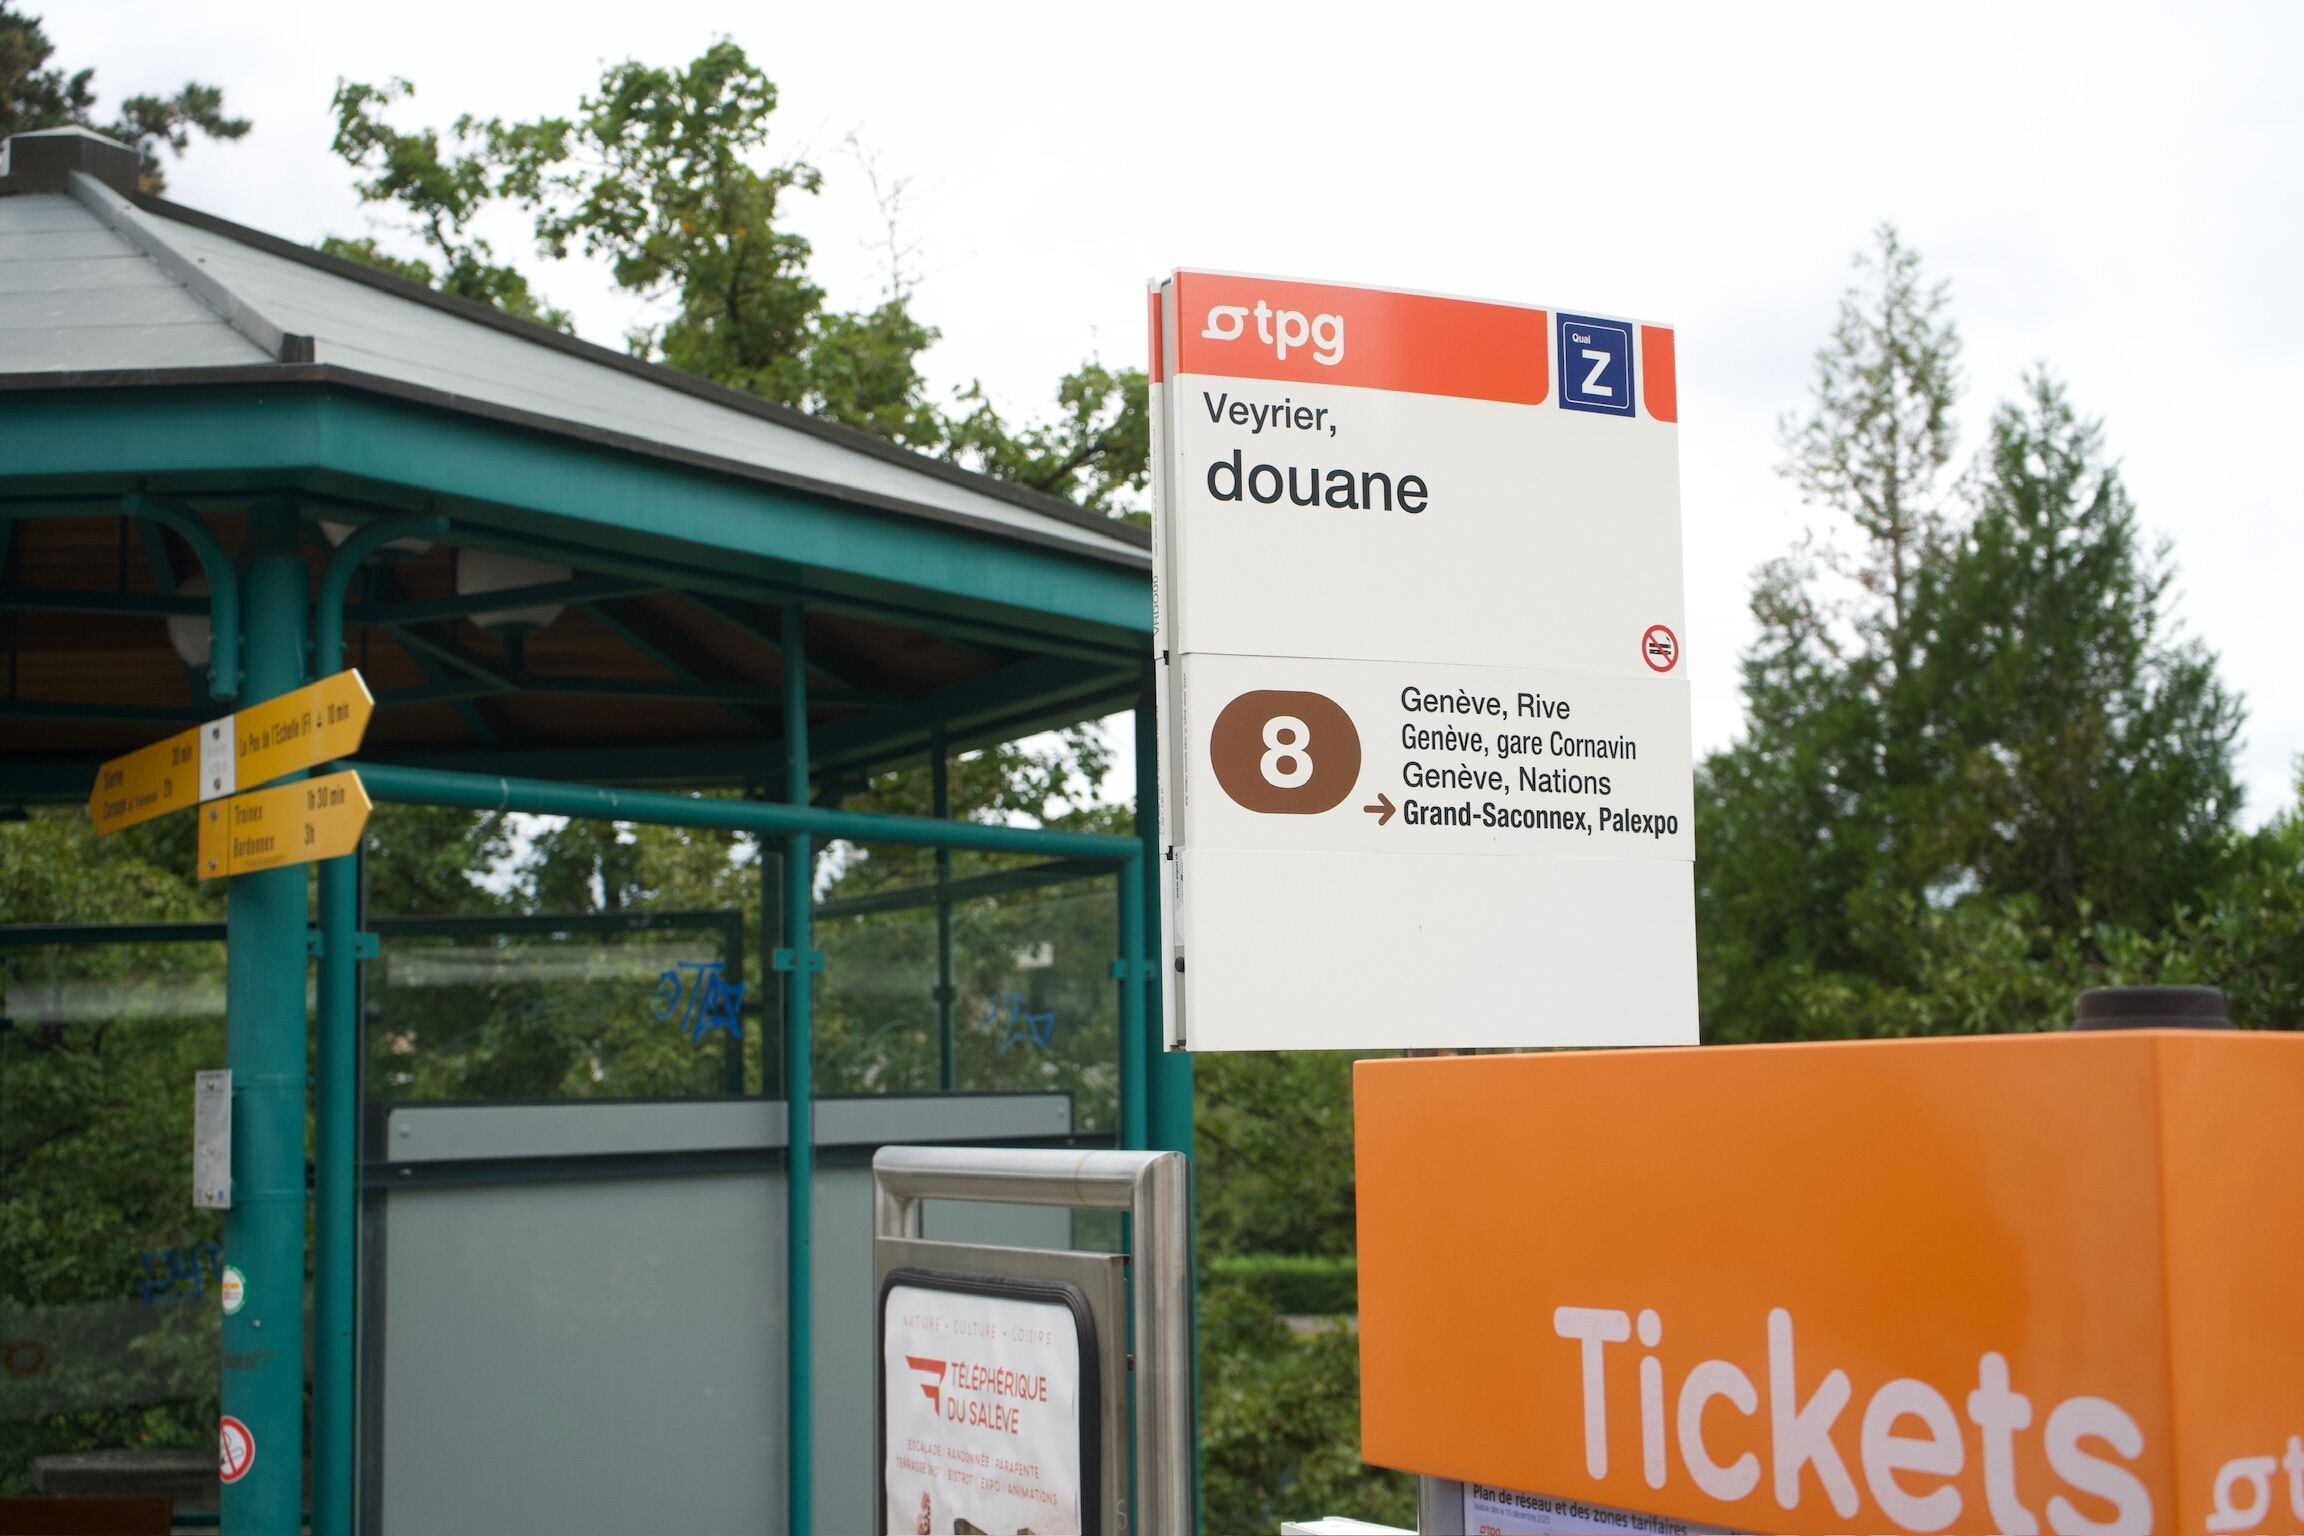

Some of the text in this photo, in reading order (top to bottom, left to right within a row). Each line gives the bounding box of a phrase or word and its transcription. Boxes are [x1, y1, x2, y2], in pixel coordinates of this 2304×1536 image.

[1571, 332, 1592, 345] Quai
[1580, 349, 1614, 397] Z
[1203, 391, 1337, 437] Veyrier,
[1206, 449, 1429, 514] douane
[1401, 686, 1570, 720] Genève, Rive
[1259, 714, 1314, 789] 8
[1402, 724, 1637, 761] Genève, gare Cornavin
[1403, 761, 1612, 797] Genève, Nations
[1403, 800, 1679, 840] Grand-Saconnex, Palexpo
[903, 1315, 1052, 1345] NATURE CULTURE LOISIRS
[951, 1360, 1047, 1402] TÉLÉPHÉRIQUE
[947, 1397, 966, 1423] DU
[1553, 1305, 2155, 1536] Tickets
[907, 1439, 1040, 1479] ESCALADE RANDONNÉE PARAPENTE
[980, 1476, 1001, 1493] EXPO
[1007, 1483, 1058, 1506] ANIMATIONS
[1473, 1483, 1687, 1536] Plan de réseau et des zones tarifaires
